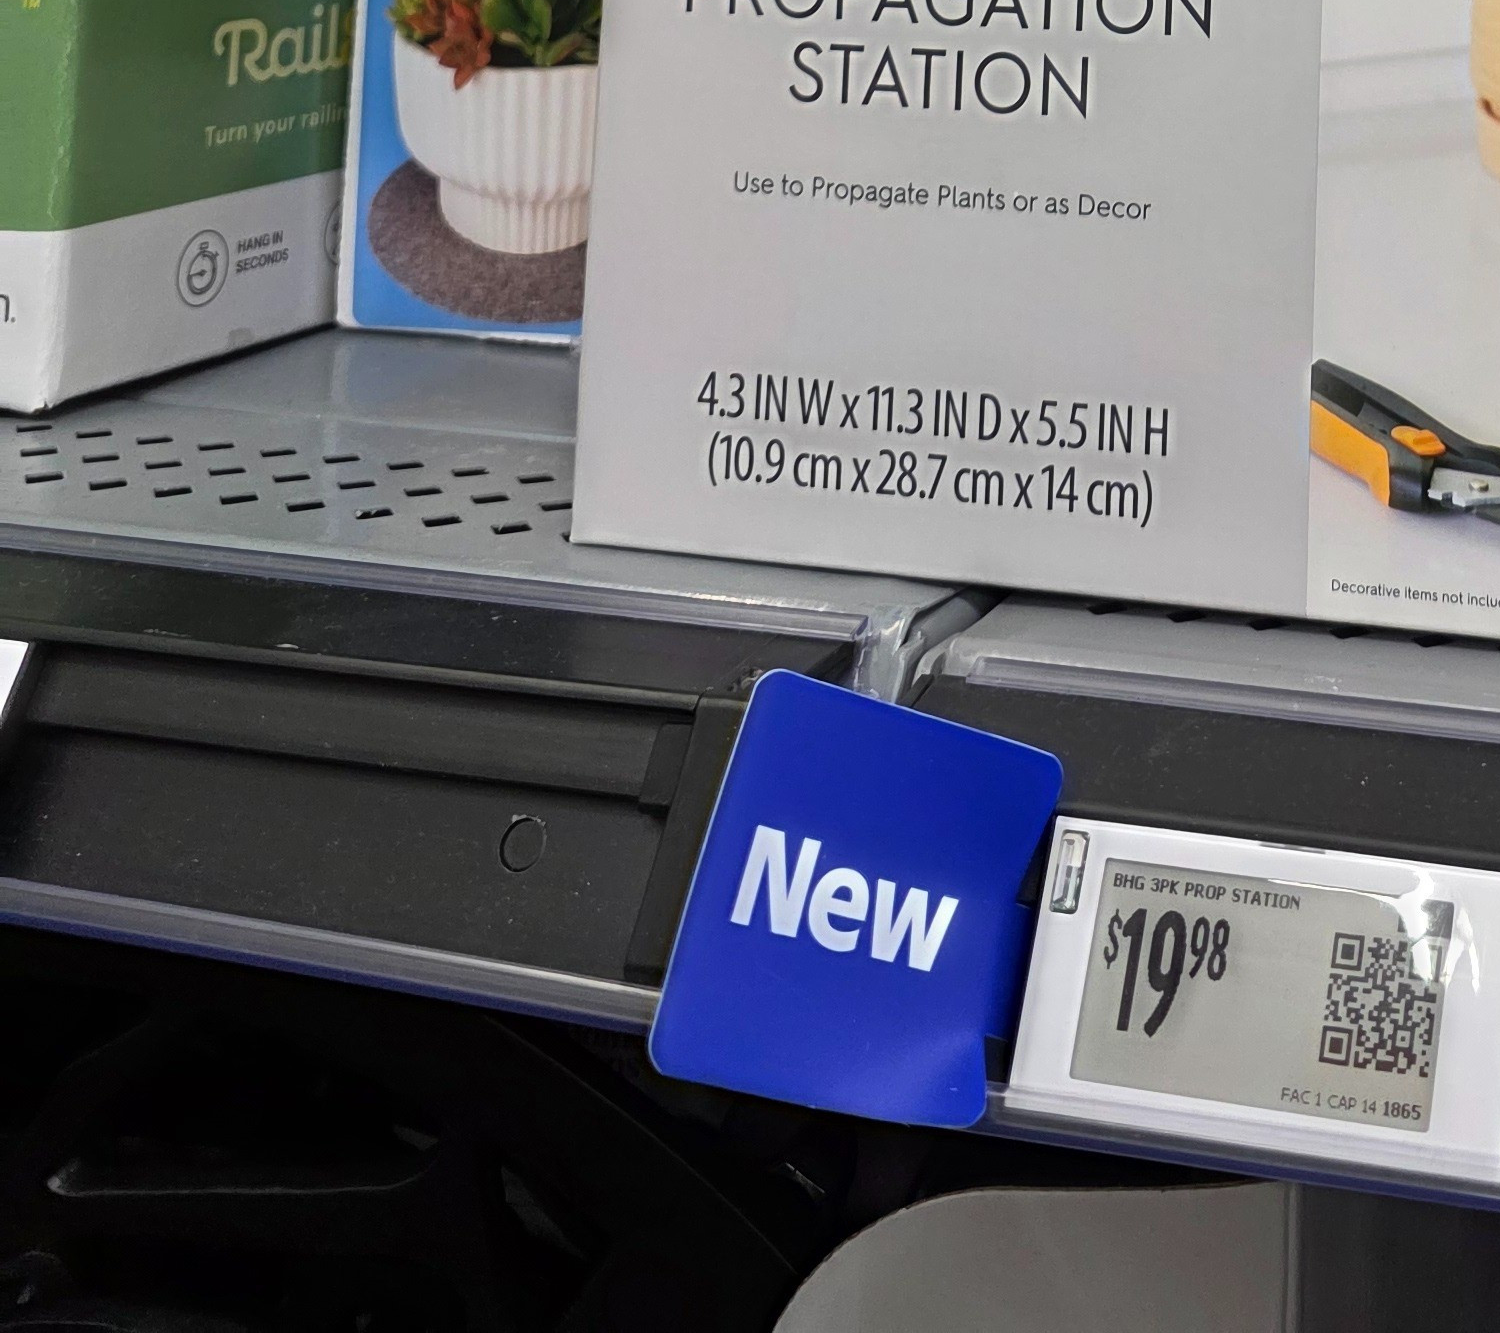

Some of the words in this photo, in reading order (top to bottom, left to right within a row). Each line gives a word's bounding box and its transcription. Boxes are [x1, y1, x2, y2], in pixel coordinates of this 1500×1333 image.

[214, 3, 357, 86] Rail
[789, 41, 1089, 120] STATION
[205, 124, 248, 147] Turn
[254, 113, 296, 143] your
[733, 170, 774, 197] Use
[781, 175, 804, 198] to
[811, 176, 929, 209] Propagate
[937, 185, 1006, 212] Plants
[1012, 191, 1038, 213] or
[1044, 195, 1070, 215] as
[1078, 193, 1152, 221] Decor
[236, 247, 290, 273] SECONDS
[237, 232, 271, 253] HANG
[272, 230, 284, 244] IN
[797, 376, 834, 426] W
[1144, 407, 1170, 456] H
[707, 430, 786, 487] (10.9
[792, 451, 842, 491] cm
[953, 464, 1004, 506] cm
[1086, 469, 1155, 528] cm)
[1331, 578, 1400, 598] Decorative
[1404, 586, 1438, 602] items
[1442, 591, 1463, 605] not
[730, 824, 960, 972] New
[1113, 872, 1145, 890] BHG
[1150, 877, 1181, 895] 3PK
[1184, 882, 1226, 900] PROP
[1231, 887, 1301, 911] STATION
[1280, 1087, 1311, 1105] FAC
[1315, 1092, 1321, 1106] 1
[1327, 1094, 1357, 1110] CAP
[1362, 1099, 1377, 1114] 14
[1383, 1100, 1423, 1120] 1865
